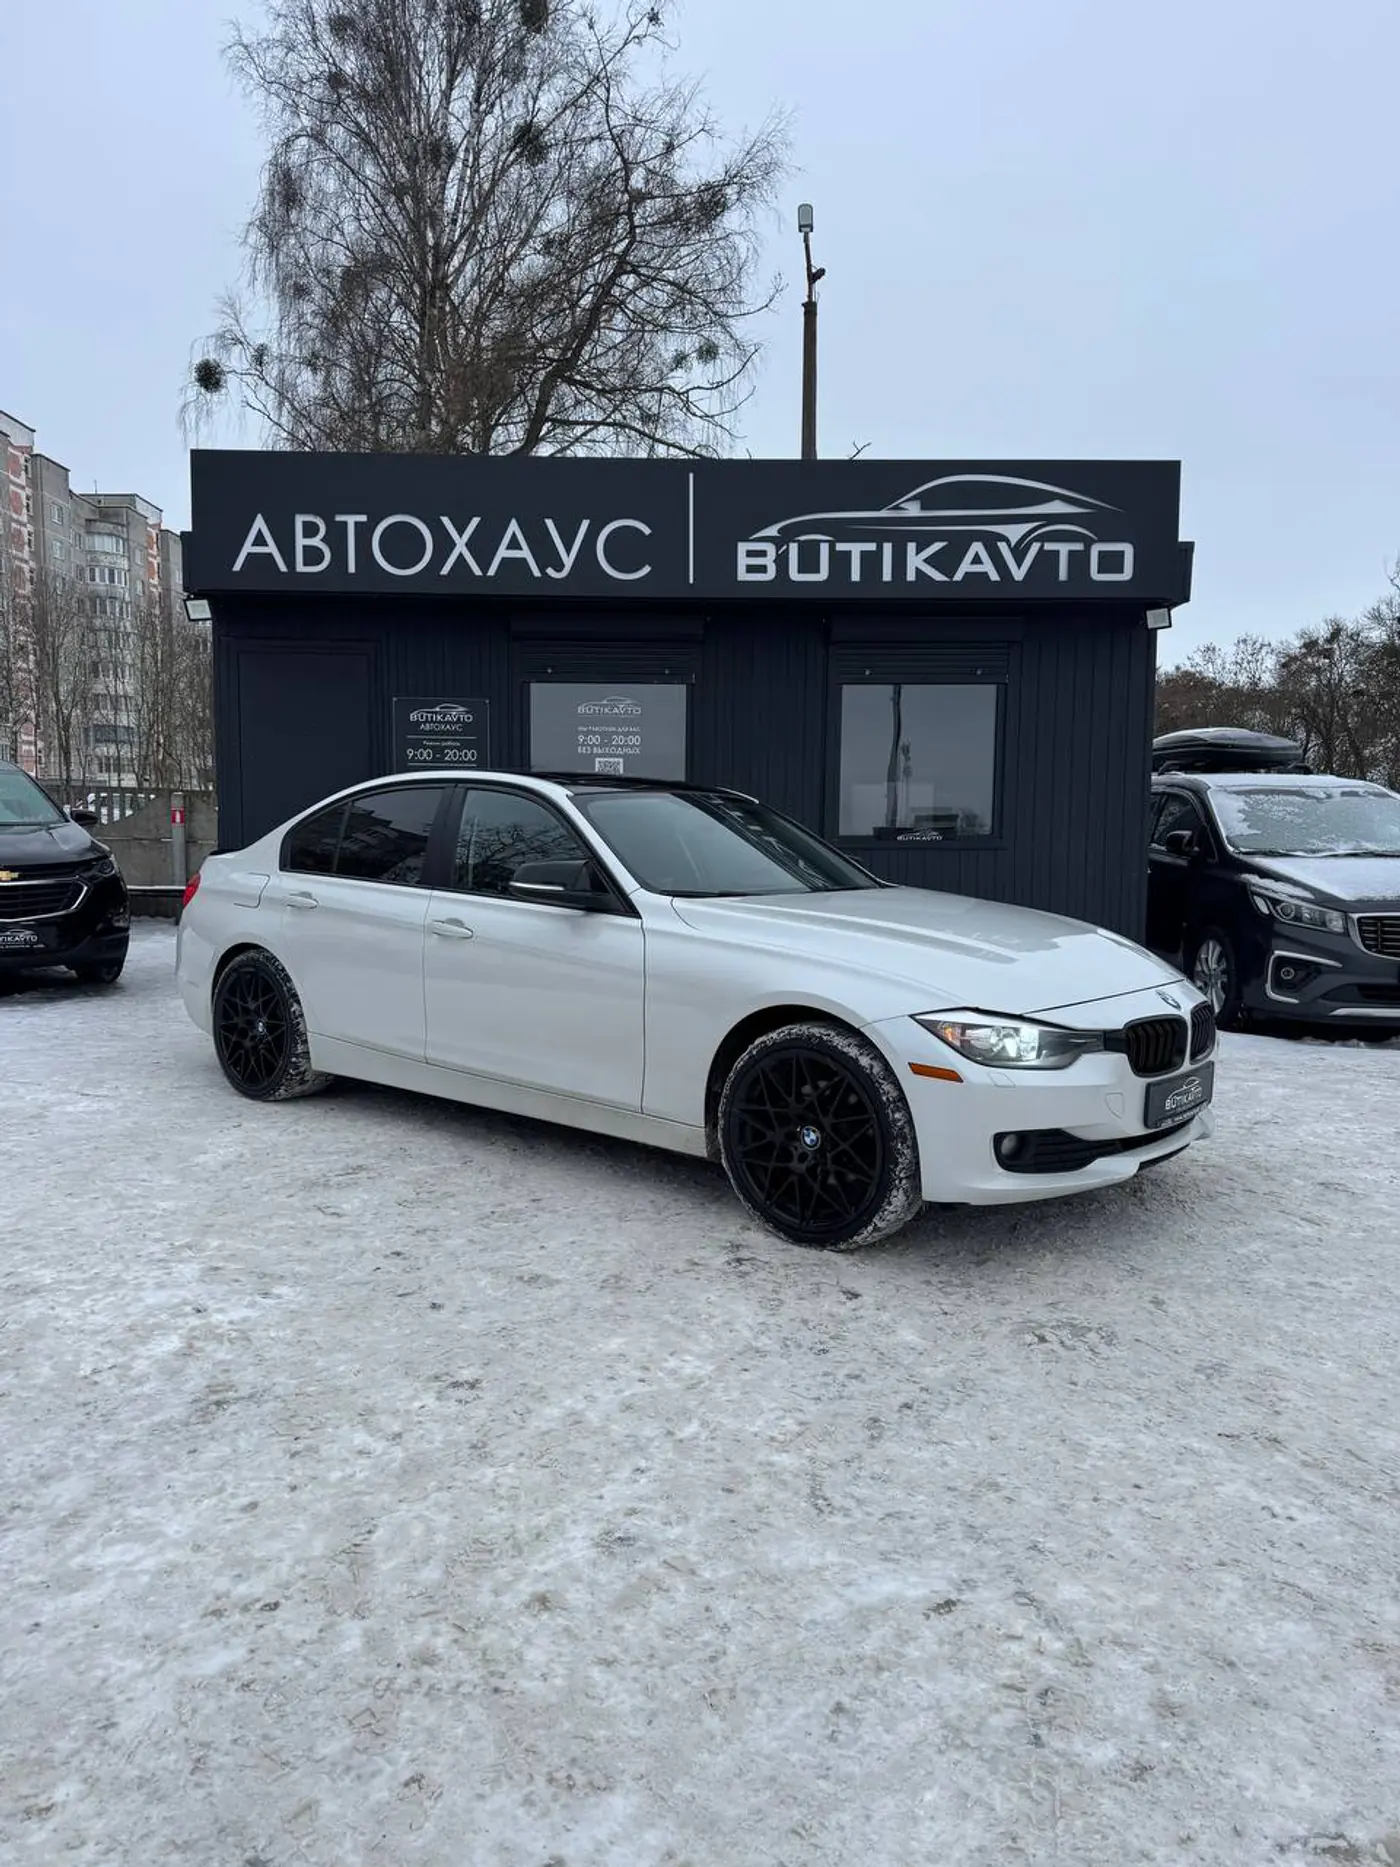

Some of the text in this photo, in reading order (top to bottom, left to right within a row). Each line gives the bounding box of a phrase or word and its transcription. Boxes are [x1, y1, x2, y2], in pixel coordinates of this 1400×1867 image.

[231, 512, 653, 581] АВТОХАУС
[736, 541, 1134, 582] BUTIKAVTO
[577, 705, 642, 715] BUTIKAVTO
[409, 712, 473, 722] BUTIKAVTO
[420, 723, 463, 731] АВТОХАУС
[577, 734, 601, 745] 9:00
[611, 735, 641, 745] 20:00
[406, 748, 433, 760] 9:00
[444, 749, 477, 761] 20:00
